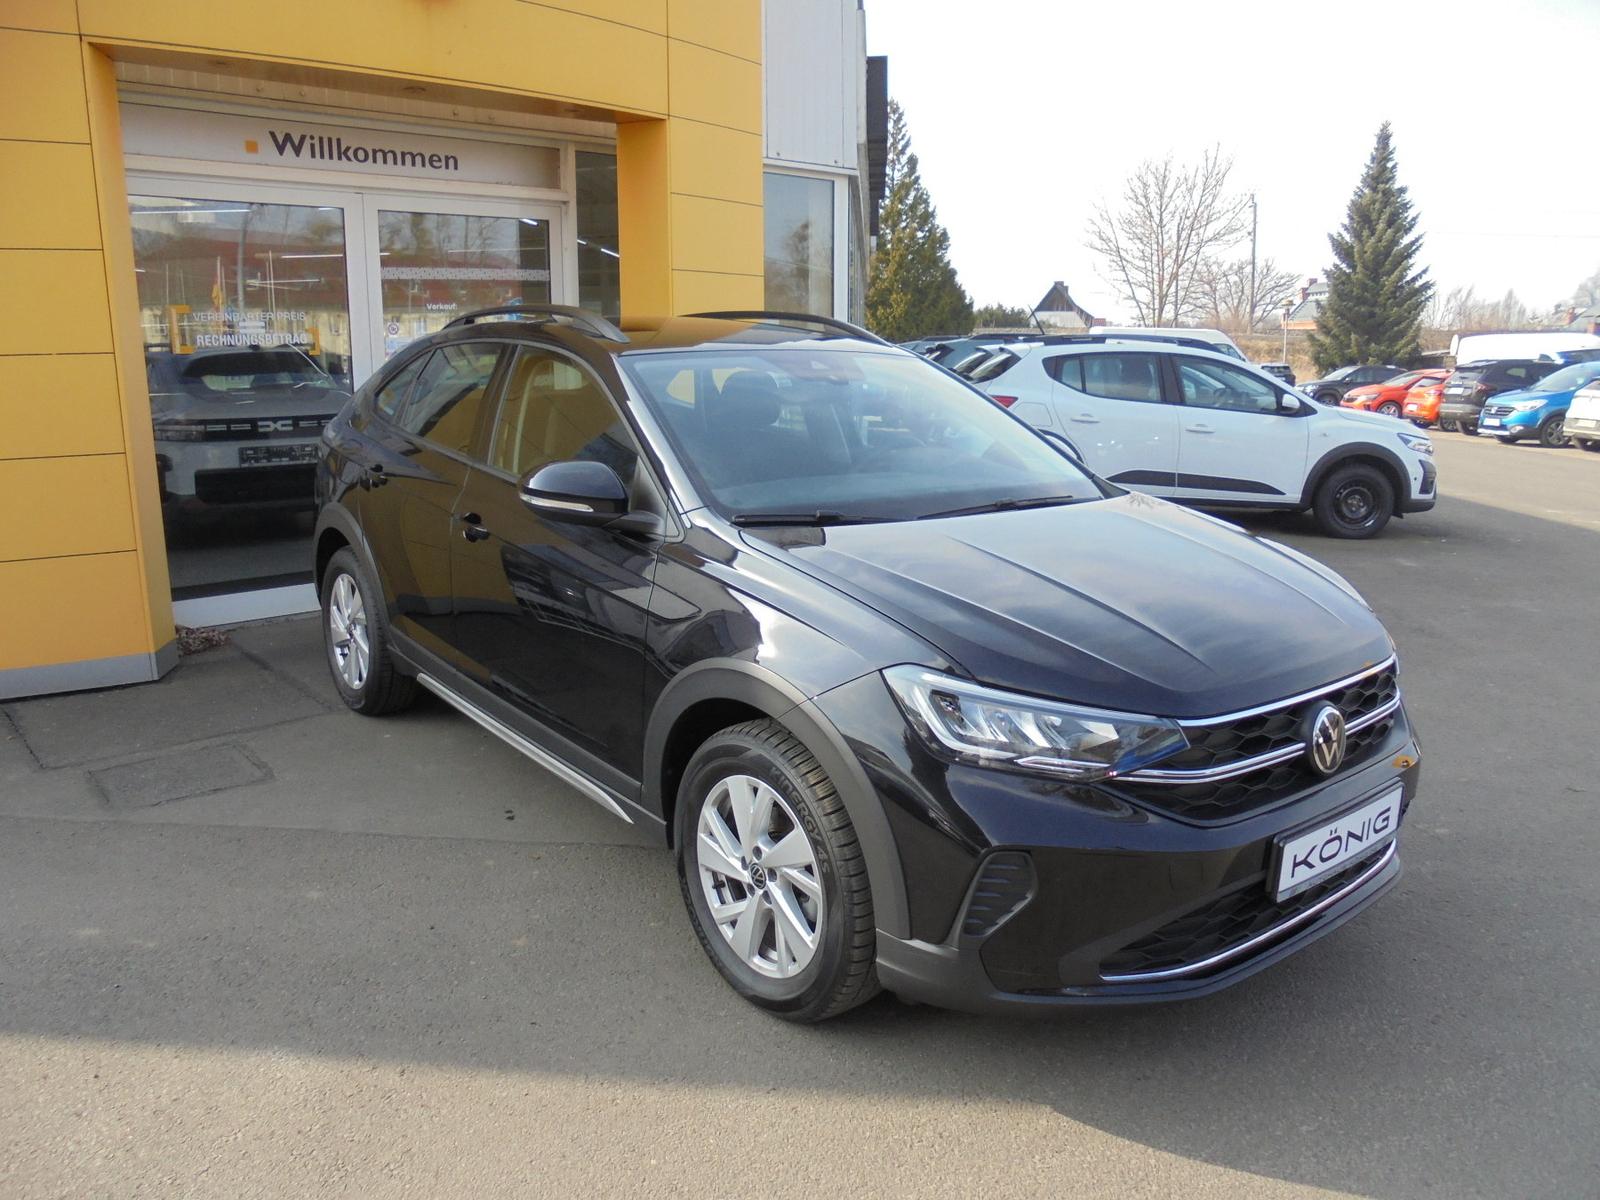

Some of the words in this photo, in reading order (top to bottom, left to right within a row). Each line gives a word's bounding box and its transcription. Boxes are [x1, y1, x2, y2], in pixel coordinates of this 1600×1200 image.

[269, 131, 459, 170] Willkommen
[193, 311, 275, 323] VEREINBARTER
[276, 311, 307, 322] PREIS
[196, 333, 308, 348] RECHNUNGSBETRAG
[1290, 807, 1391, 877] KÖNIG
